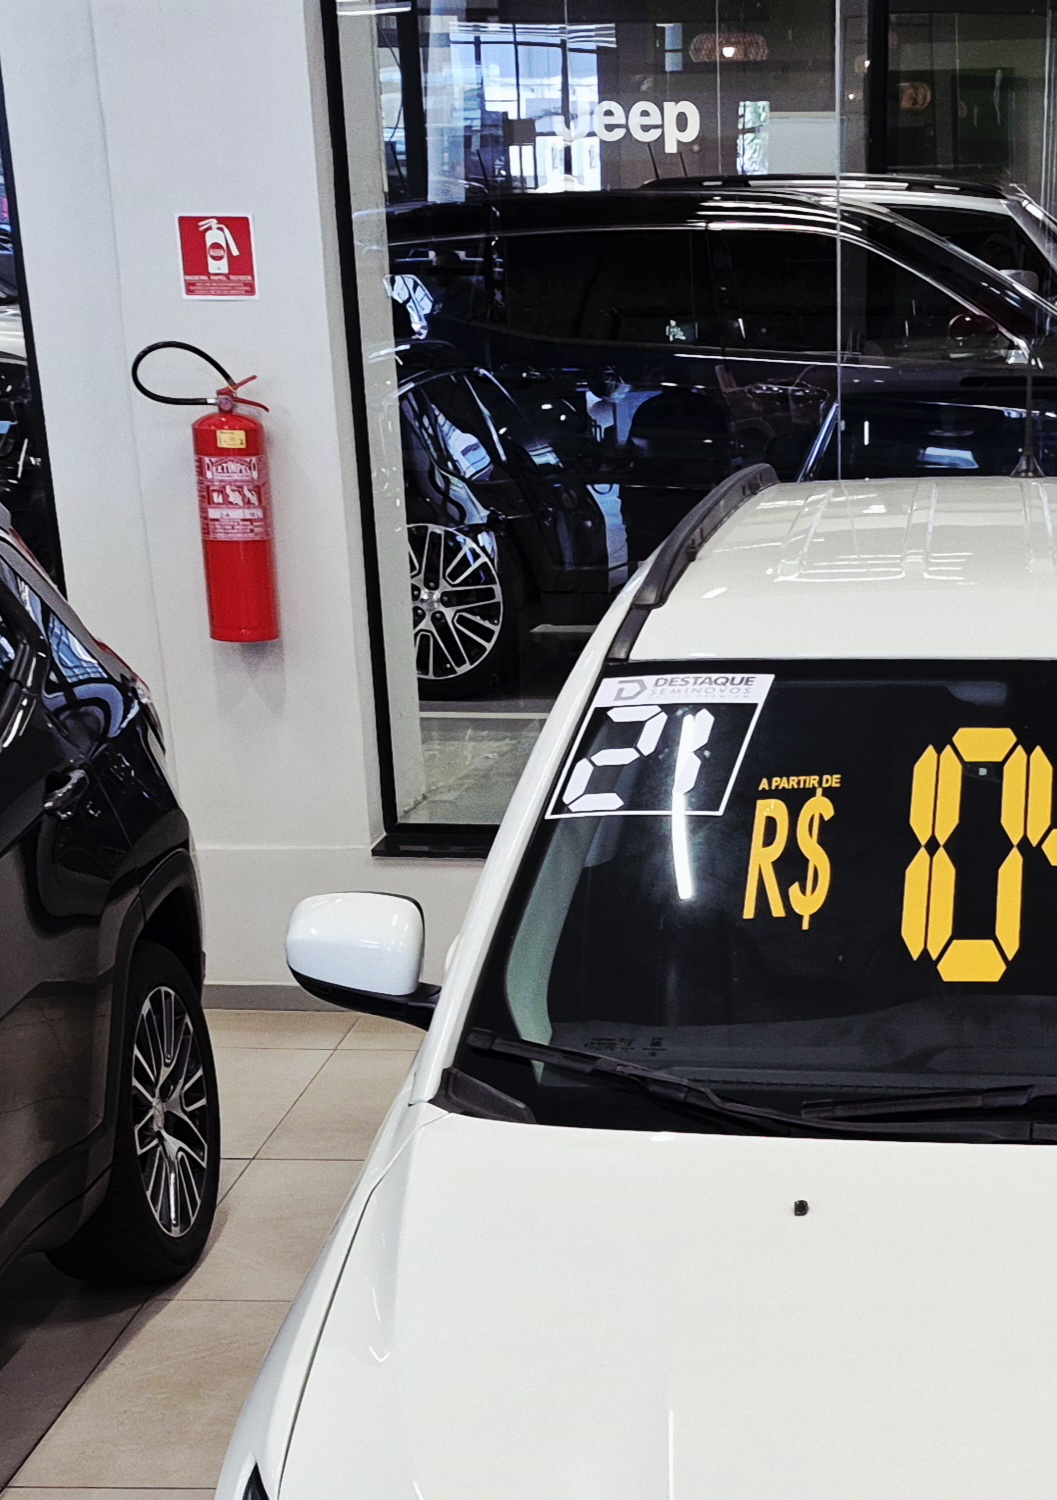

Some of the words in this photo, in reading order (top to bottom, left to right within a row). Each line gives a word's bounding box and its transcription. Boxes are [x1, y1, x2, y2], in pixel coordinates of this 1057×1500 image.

[654, 677, 756, 687] DESTAQUE
[650, 687, 752, 695] SEMINOVOS
[758, 778, 769, 790] A
[771, 776, 819, 789] PARTIR
[821, 775, 842, 788] DE
[743, 787, 835, 930] R$
